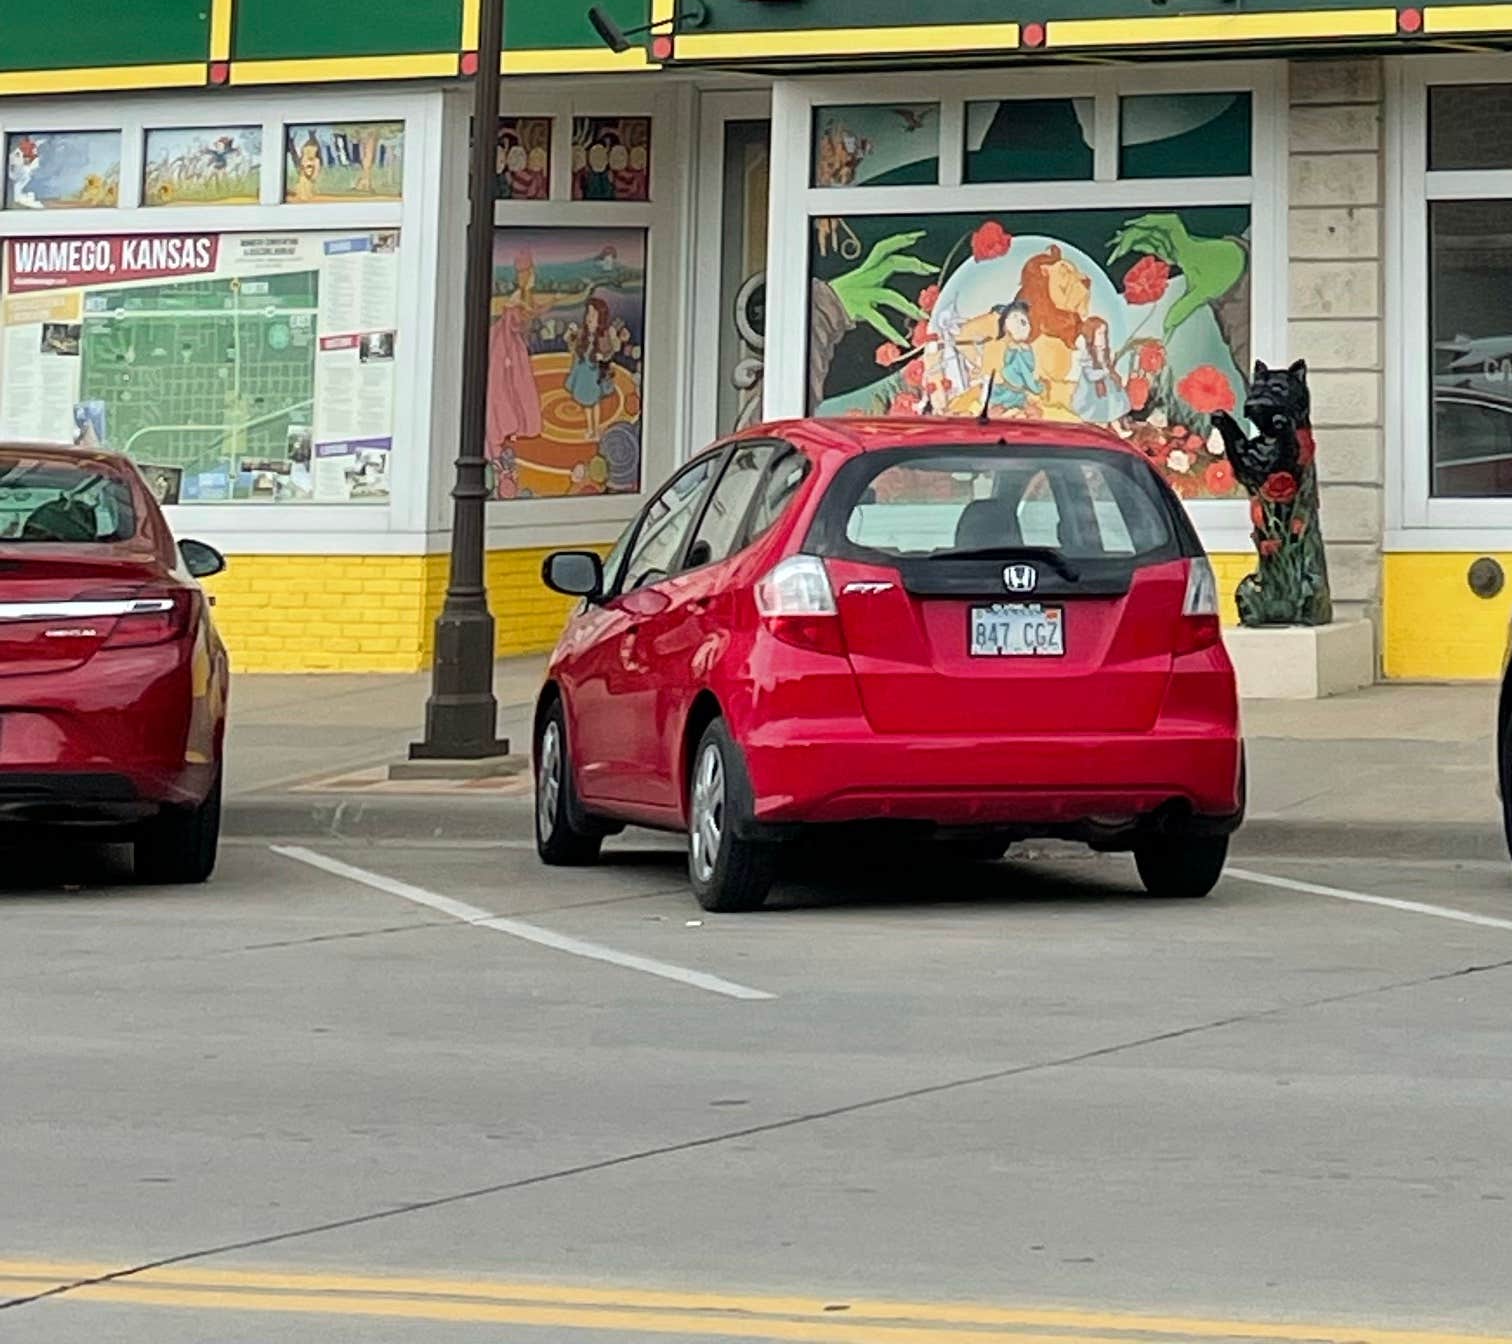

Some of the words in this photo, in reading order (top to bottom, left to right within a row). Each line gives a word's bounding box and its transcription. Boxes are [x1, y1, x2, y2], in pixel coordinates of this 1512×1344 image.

[14, 240, 116, 274] WAMEGO,
[121, 238, 210, 270] KANSAS
[975, 622, 1010, 648] 847
